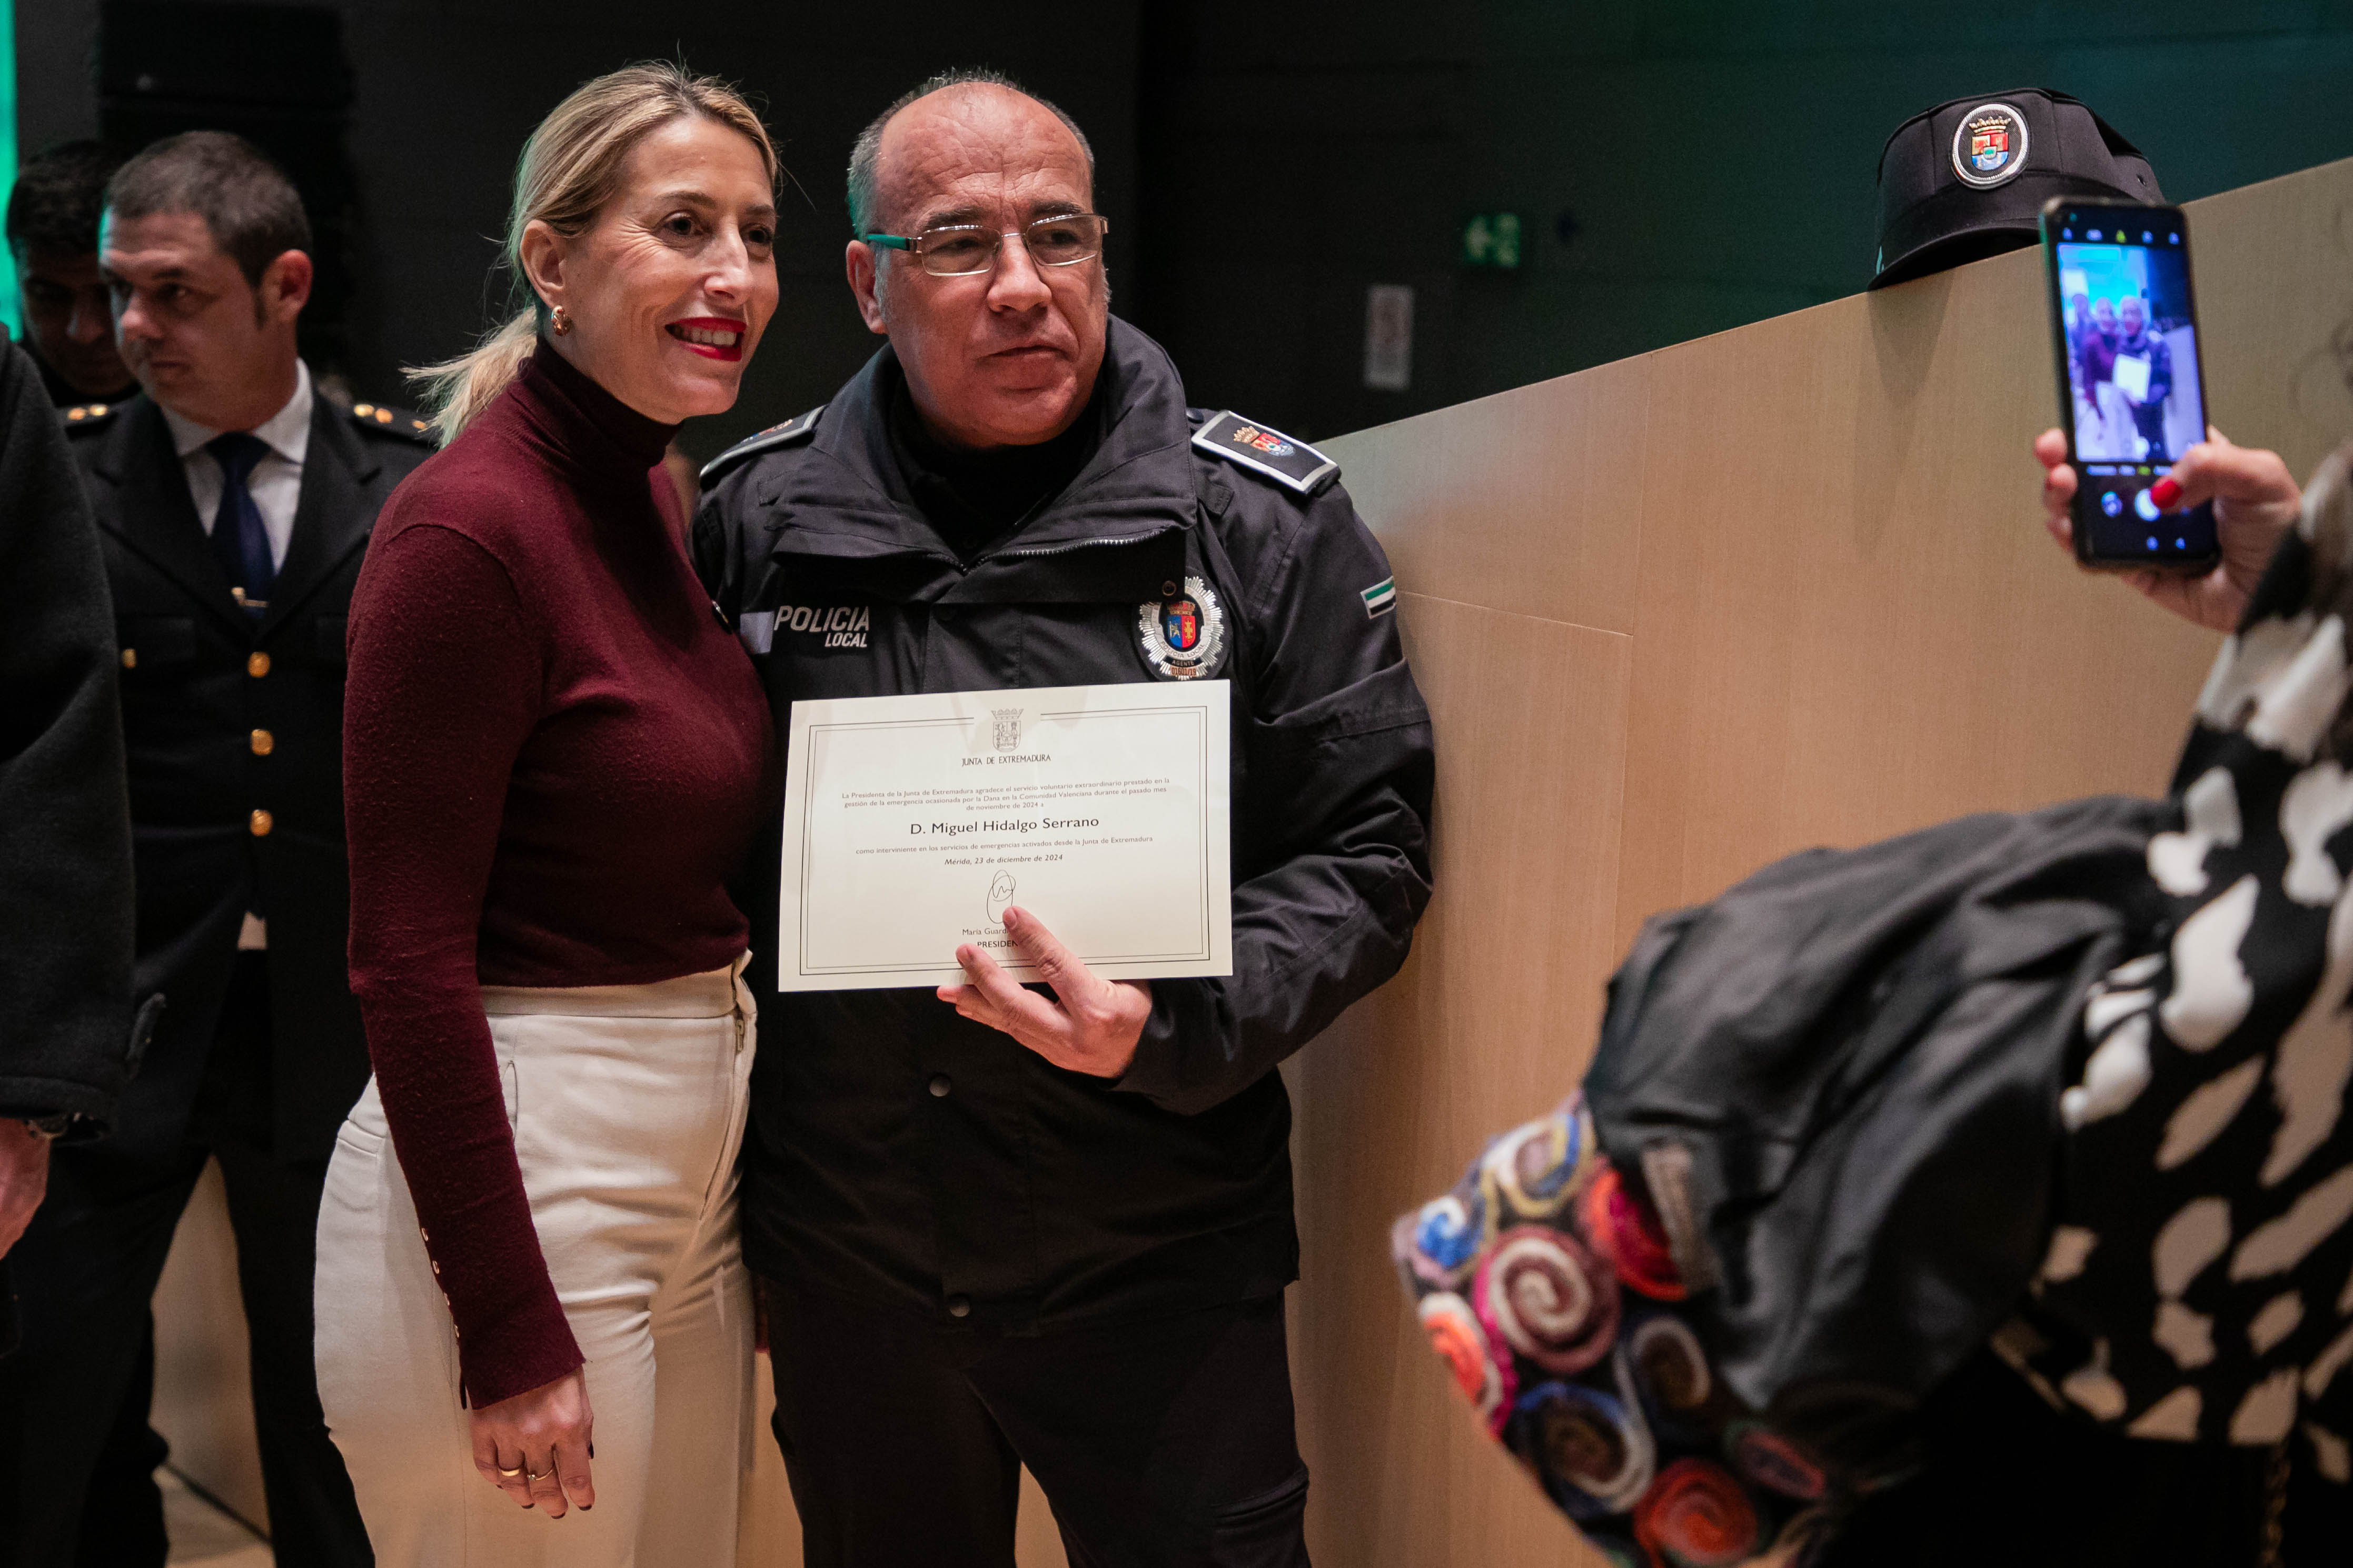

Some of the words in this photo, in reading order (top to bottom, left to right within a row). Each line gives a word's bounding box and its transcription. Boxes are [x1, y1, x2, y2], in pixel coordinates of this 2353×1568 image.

[773, 605, 869, 632] POLICIA
[825, 633, 868, 648] LOCAL
[1187, 644, 1205, 657] LOCAL
[962, 758, 982, 766] JUNTA
[999, 754, 1051, 764] EXTREMADURA
[911, 824, 926, 834] D.
[932, 821, 977, 836] Miguel
[984, 820, 1037, 833] Hidalgo
[1043, 818, 1099, 828] Serrano
[977, 939, 1018, 948] PRESIDEN
